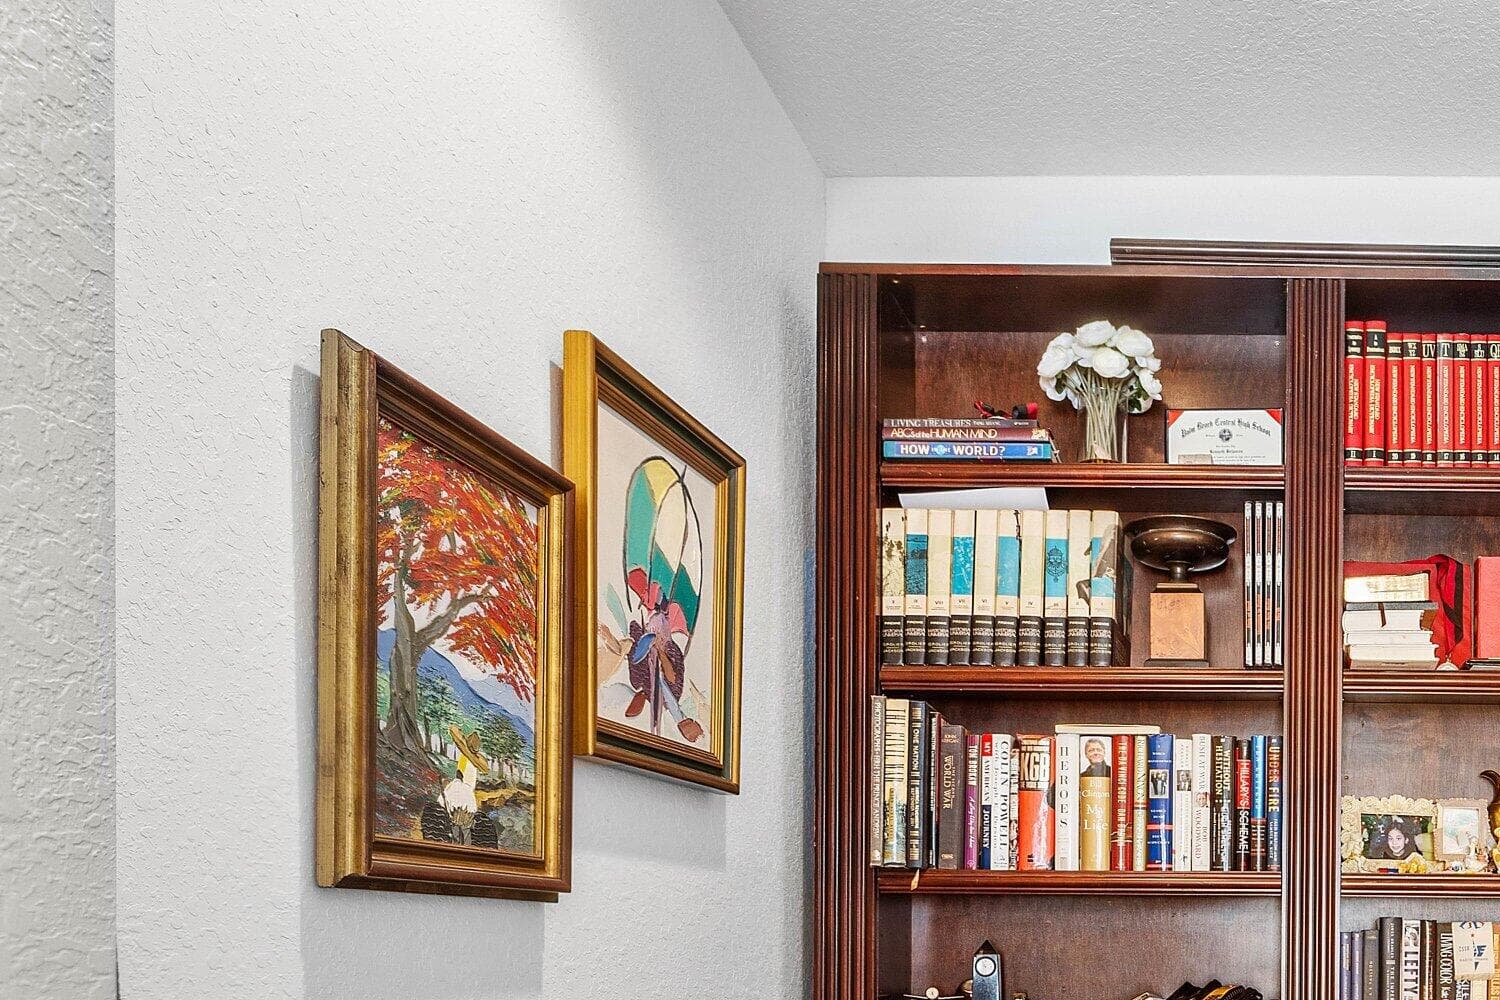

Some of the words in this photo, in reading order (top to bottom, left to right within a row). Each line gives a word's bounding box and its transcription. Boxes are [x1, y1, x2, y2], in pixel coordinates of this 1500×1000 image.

[1422, 344, 1435, 357] UV
[1442, 343, 1449, 357] T
[891, 419, 921, 427] LIVING
[922, 419, 970, 427] TREASURES
[930, 429, 969, 439] HUMAN
[970, 429, 998, 439] MIND
[901, 445, 930, 455] HOW
[953, 446, 1006, 456] WORLD?
[968, 744, 978, 758] TOM
[983, 741, 990, 754] MY
[1118, 742, 1127, 754] THE
[1000, 740, 1009, 786] COLIN
[1020, 752, 1050, 781] KGB
[1118, 756, 1127, 766] DA
[1269, 746, 1280, 782] UNDER
[968, 760, 978, 786] BROKAW
[1118, 767, 1127, 785] VINCI
[1240, 762, 1249, 807] HILLARY'S
[943, 790, 951, 809] WAR
[1118, 787, 1127, 803] CODE
[1268, 787, 1280, 812] FIRE
[1087, 804, 1104, 819] My
[999, 794, 1008, 850] POWELL
[1084, 819, 1108, 830] Life
[1239, 810, 1249, 850] SCHEME
[1440, 932, 1453, 957] LIVING
[1404, 951, 1419, 994] LEFTY
[1440, 958, 1452, 984] COLOR
